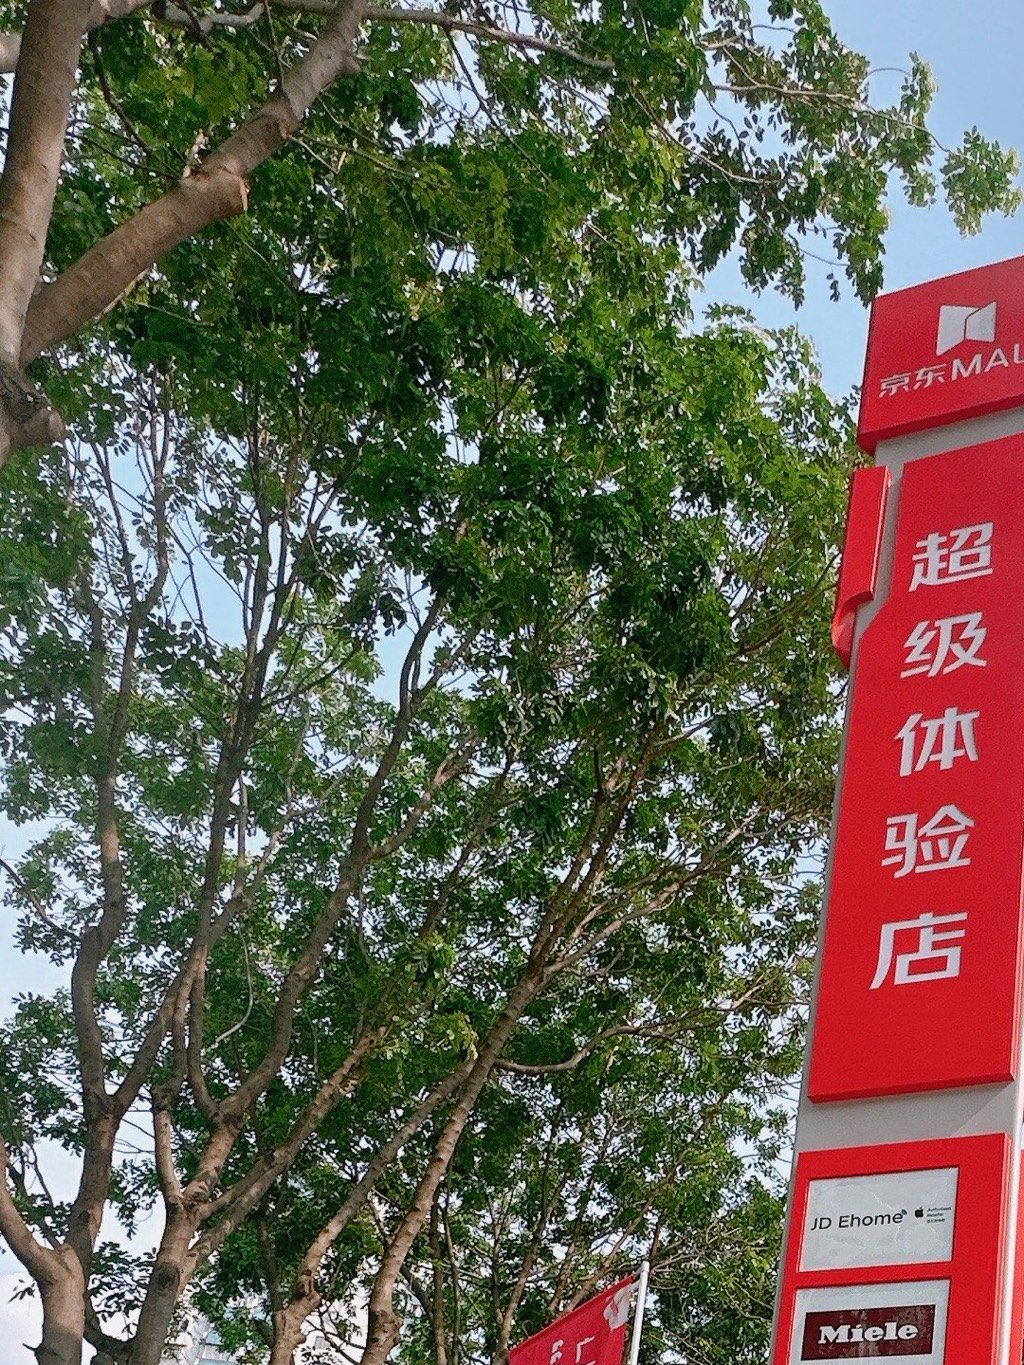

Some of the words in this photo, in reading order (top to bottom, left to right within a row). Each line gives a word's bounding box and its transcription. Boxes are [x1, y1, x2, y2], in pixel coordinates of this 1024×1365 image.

[870, 521, 994, 990] 超级体验店
[811, 1217, 832, 1231] JD
[838, 1212, 904, 1228] Ehome
[818, 1322, 919, 1344] Miele
